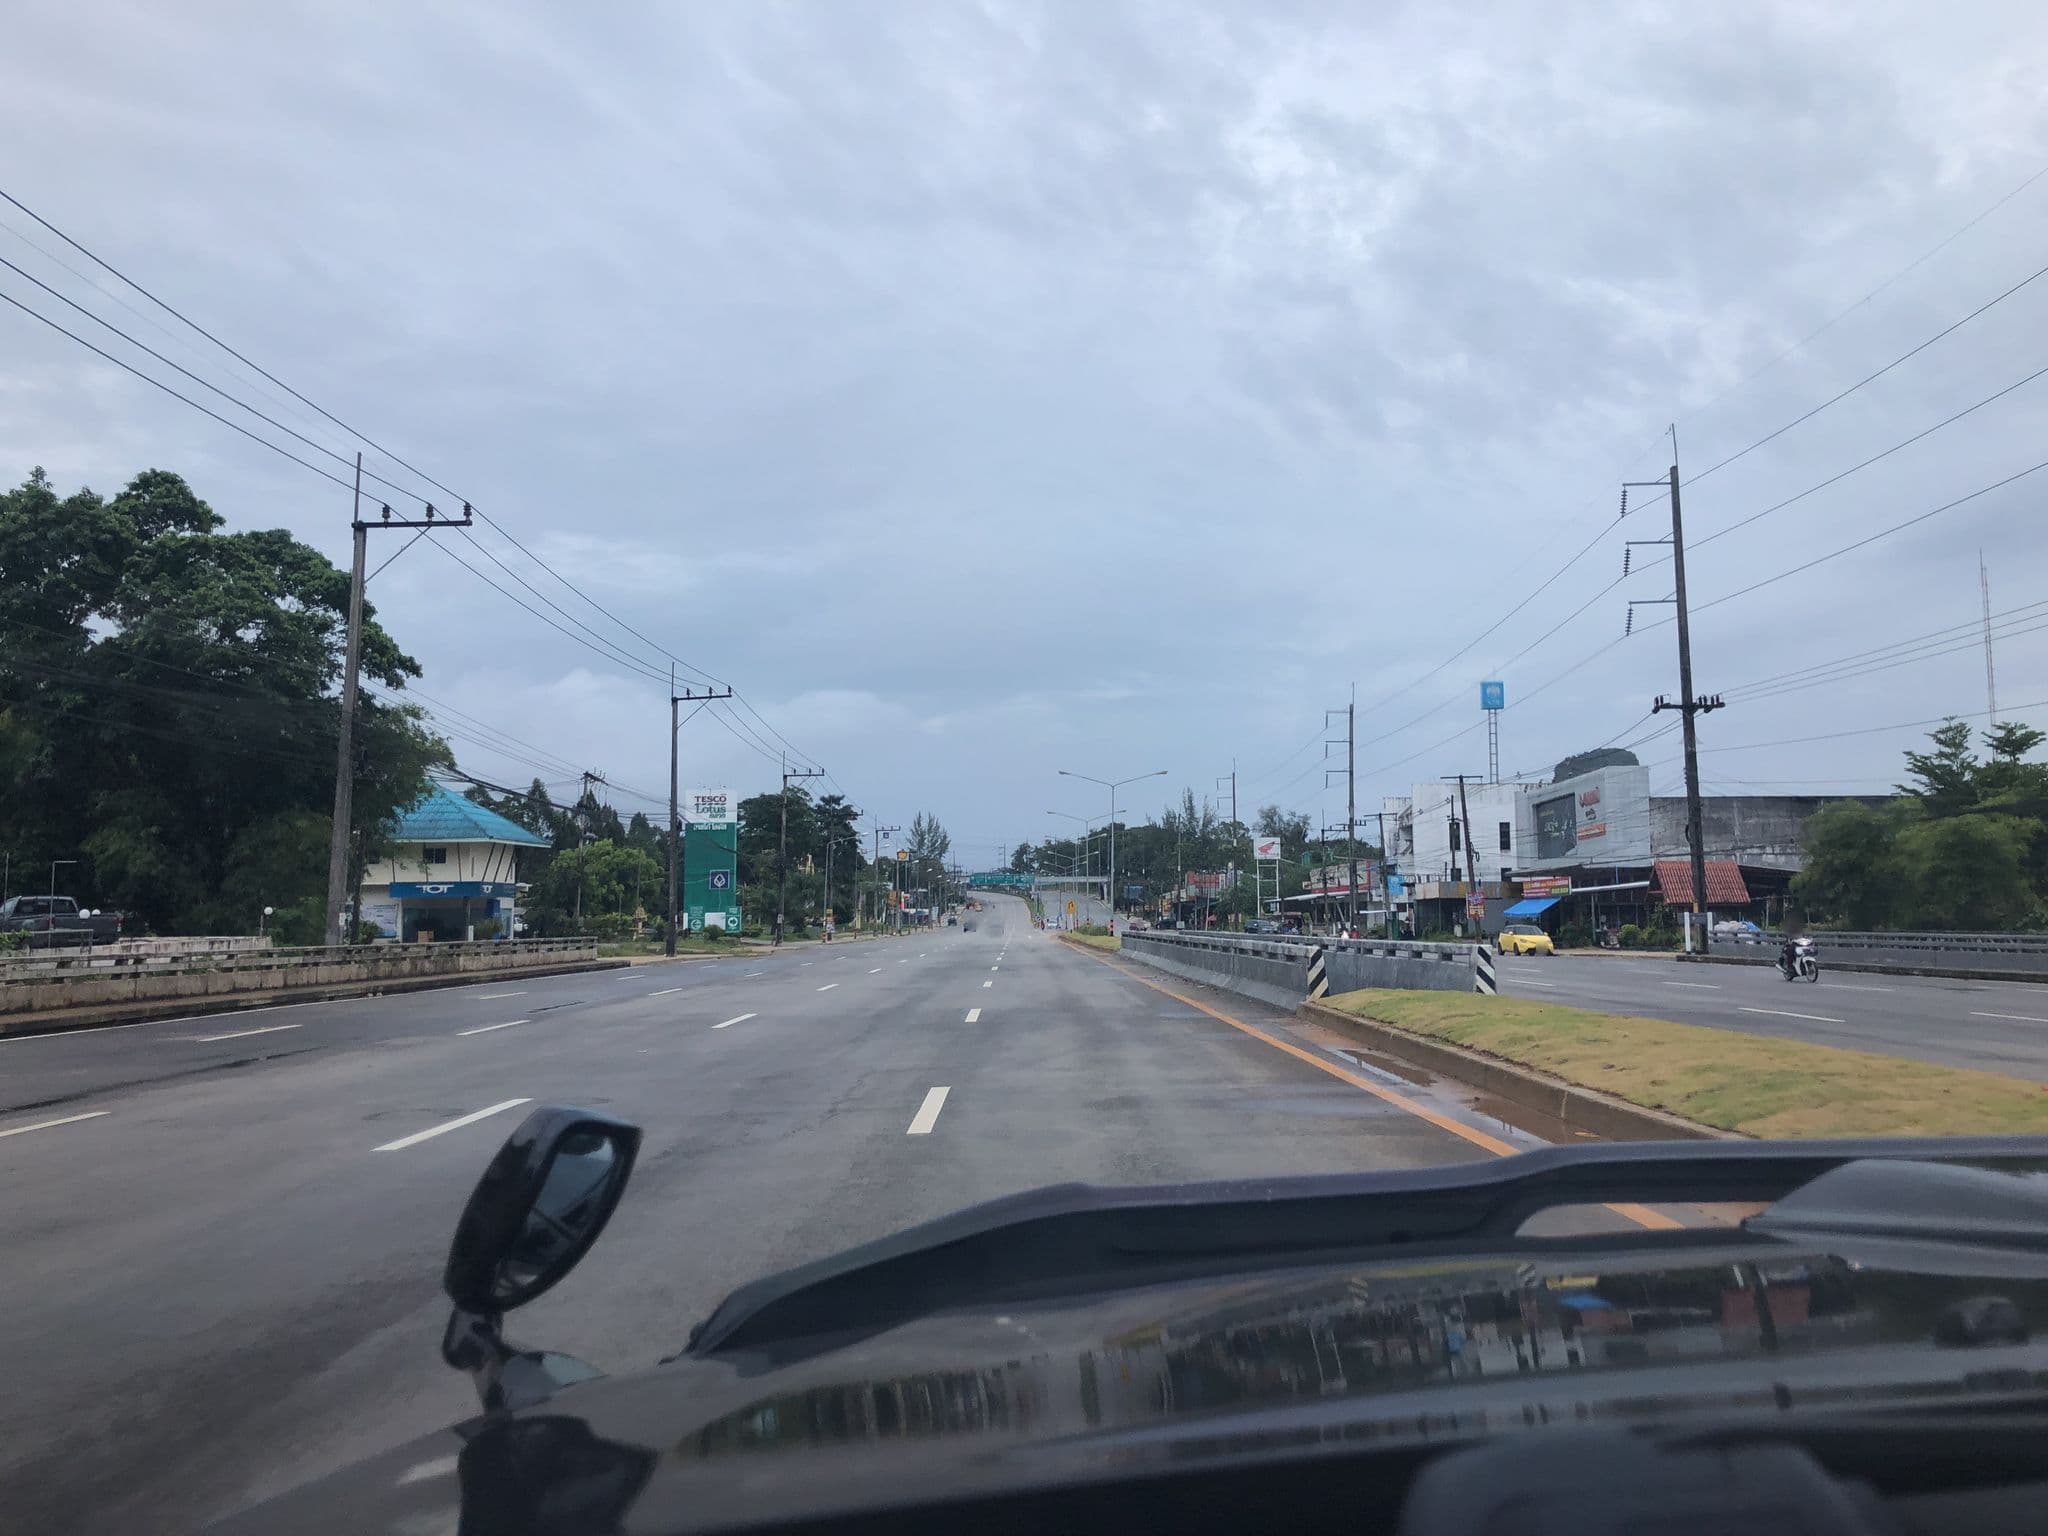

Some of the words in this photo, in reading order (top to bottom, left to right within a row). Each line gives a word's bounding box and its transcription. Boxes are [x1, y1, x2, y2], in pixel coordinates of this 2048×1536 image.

[694, 795, 727, 803] TESCO
[695, 804, 727, 814] Lotus
[416, 884, 454, 894] TOT
